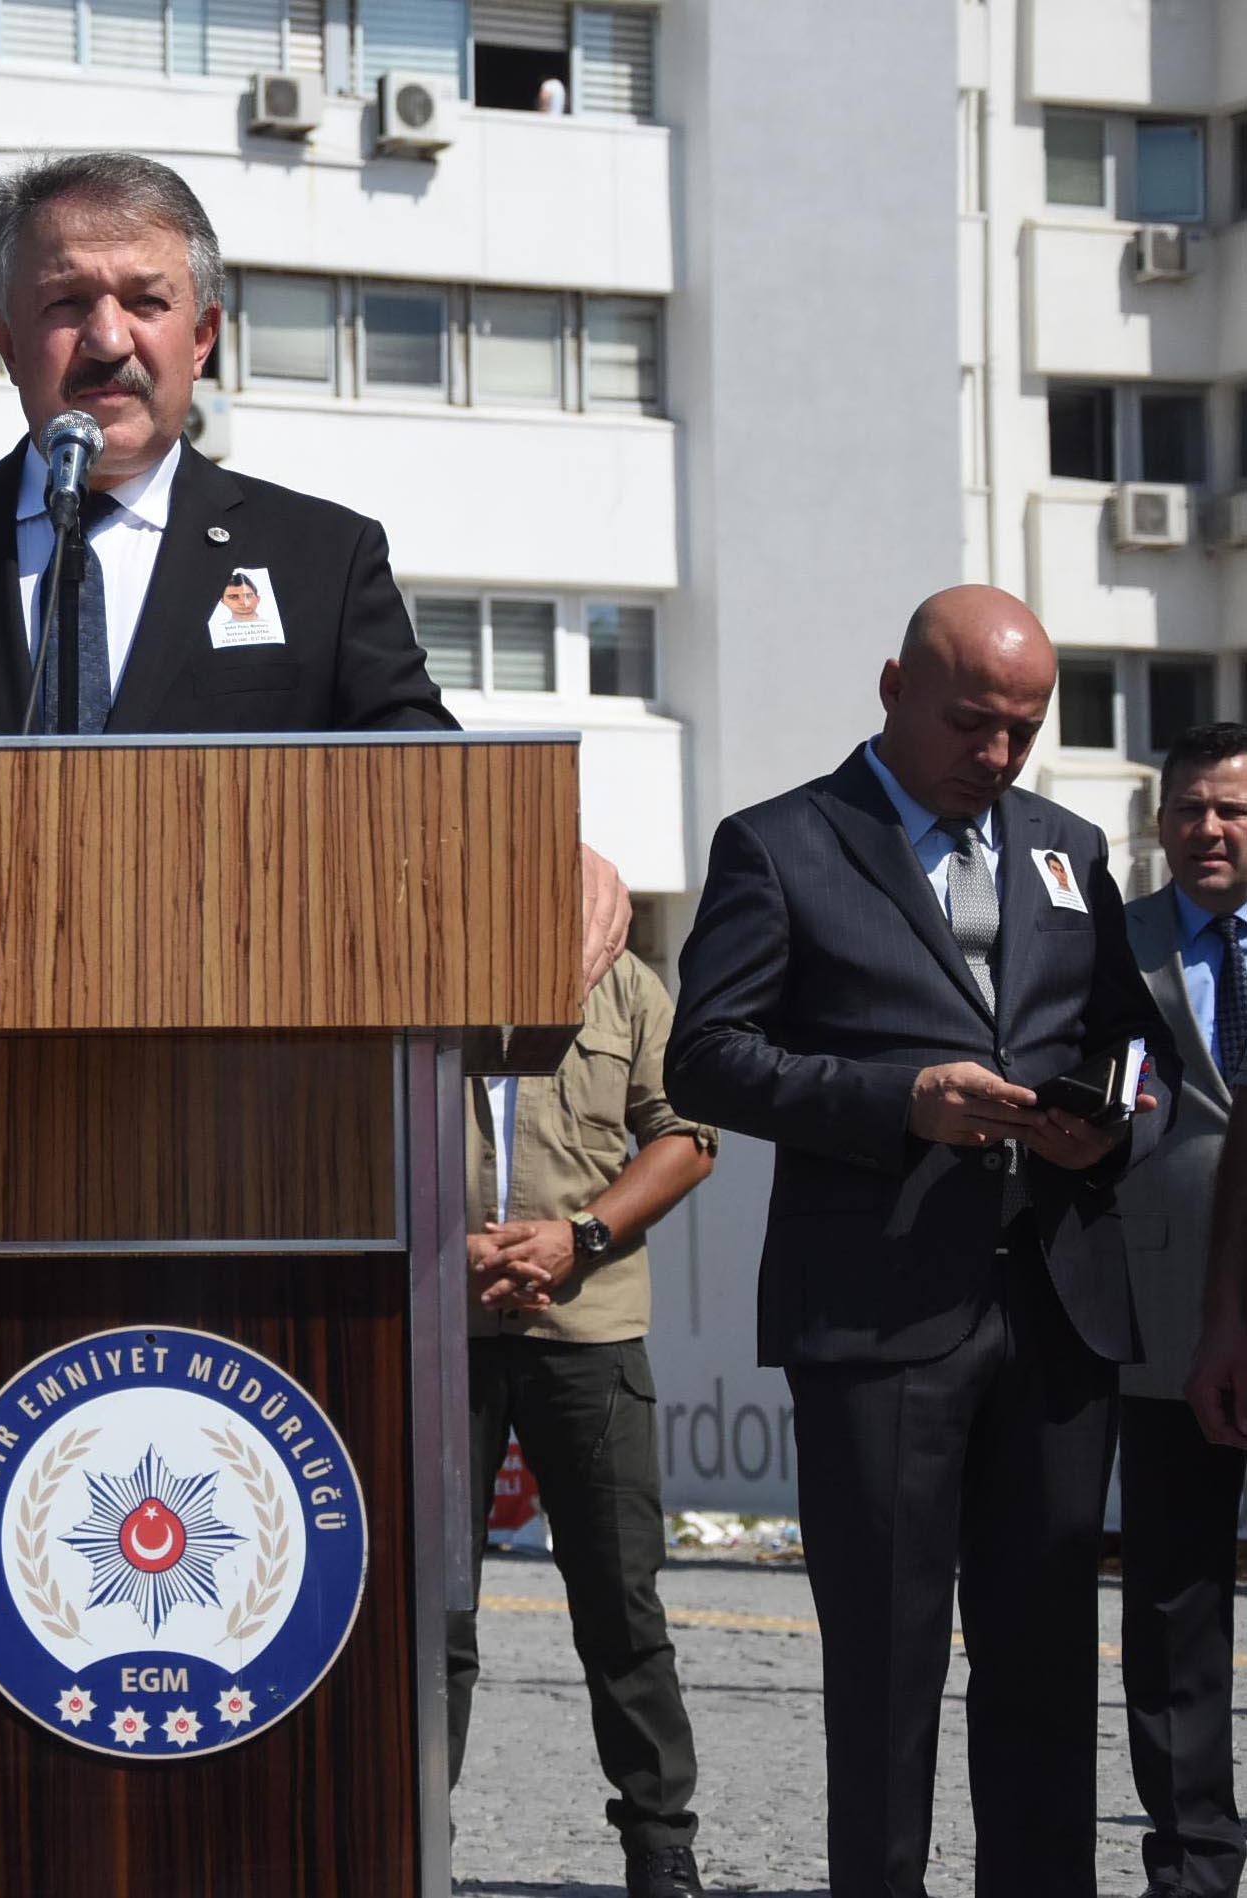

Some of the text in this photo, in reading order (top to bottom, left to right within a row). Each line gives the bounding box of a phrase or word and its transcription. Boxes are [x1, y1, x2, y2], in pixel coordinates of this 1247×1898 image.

[17, 1347, 169, 1421] EMNİYET
[187, 1353, 347, 1530] MÜDÜRLÜĞÜ
[121, 1667, 189, 1693] EGM
